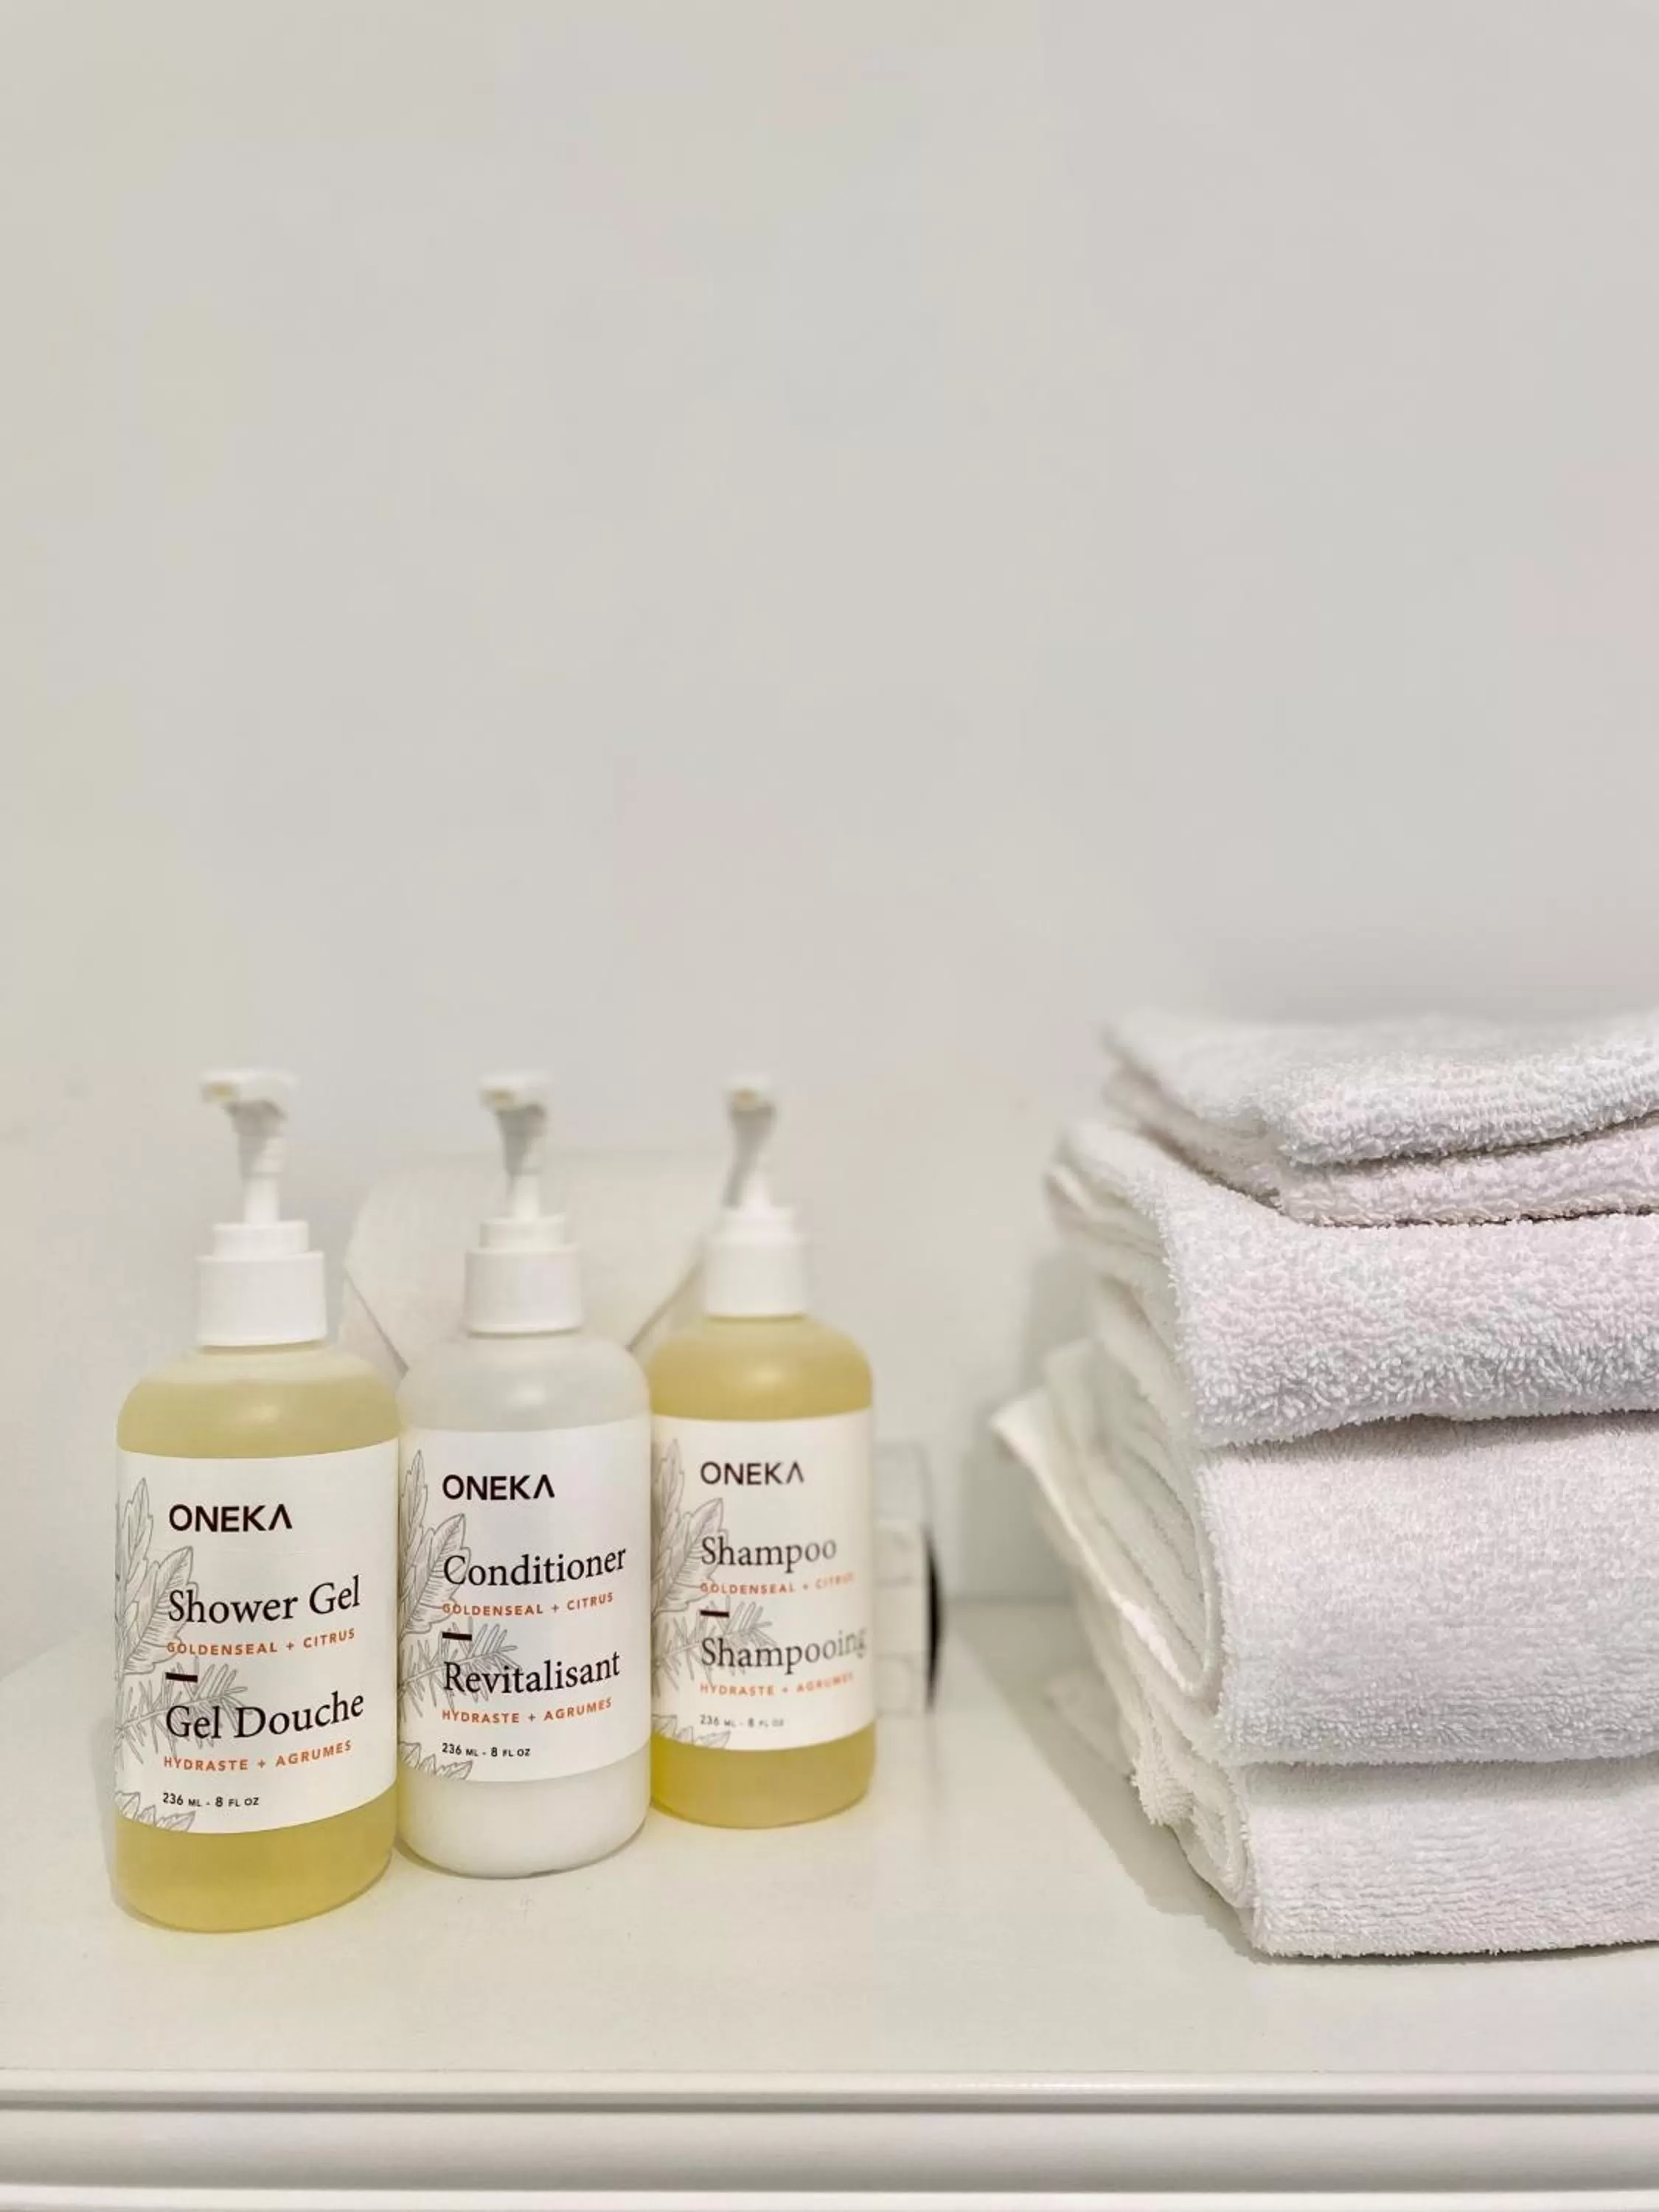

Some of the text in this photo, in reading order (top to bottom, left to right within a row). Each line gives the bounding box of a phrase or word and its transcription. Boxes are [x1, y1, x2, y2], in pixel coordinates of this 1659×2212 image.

[442, 1474, 555, 1500] ONEKA
[700, 1461, 804, 1486] ONEKA
[169, 1504, 292, 1532] ONEKA
[443, 1548, 626, 1587] Conditioner
[700, 1535, 837, 1574] Shampoo
[169, 1575, 361, 1623] Shower Gel
[700, 1582, 796, 1595] GOLDENSEAL
[442, 1603, 543, 1616] GOLDENSEAL
[566, 1592, 613, 1612] CITRUS
[167, 1642, 278, 1656] GOLDENSEAL
[303, 1628, 355, 1649] CITRUS
[701, 1627, 867, 1674] Shampooing
[443, 1651, 620, 1694] Revitalisant
[700, 1683, 774, 1696] HYDRASTE
[166, 1691, 364, 1739] Gel Douche
[442, 1709, 520, 1724] HYDRASTE
[543, 1698, 611, 1721] AGRUMES
[699, 1714, 720, 1728] 236
[164, 1756, 248, 1771] HYDRASTE
[275, 1739, 352, 1768] AGRUMES
[442, 1742, 462, 1756] 236
[465, 1747, 479, 1757] ML
[490, 1746, 498, 1758] 8
[502, 1748, 514, 1758] FL
[517, 1747, 530, 1757] OZ
[162, 1792, 184, 1806] 236
[188, 1798, 201, 1807] ML
[215, 1795, 223, 1808] 8
[229, 1798, 241, 1808] FL
[244, 1795, 260, 1806] OZ
